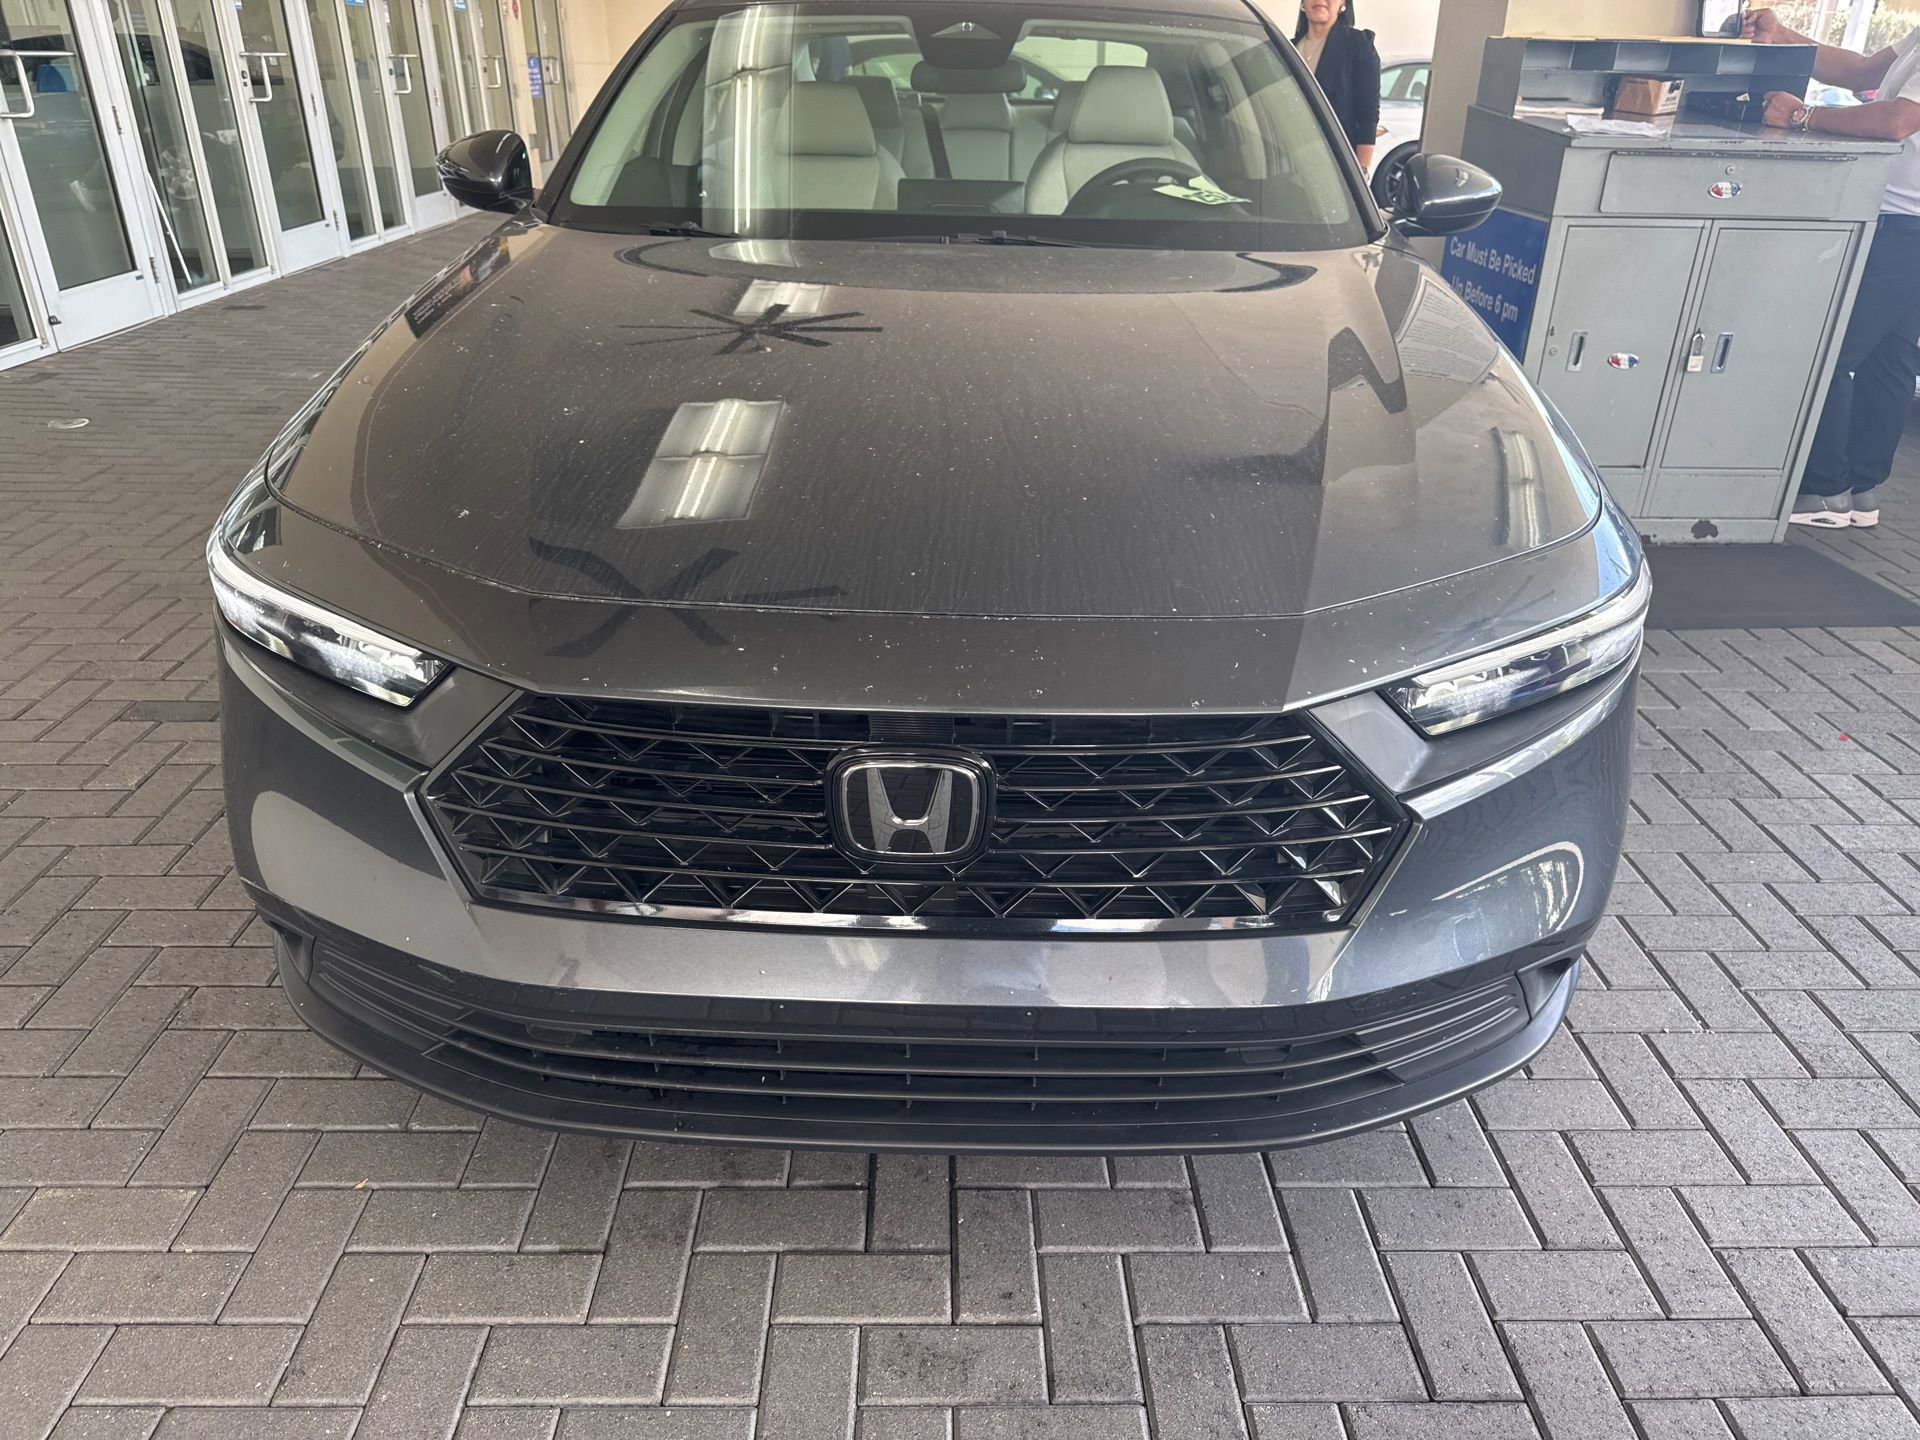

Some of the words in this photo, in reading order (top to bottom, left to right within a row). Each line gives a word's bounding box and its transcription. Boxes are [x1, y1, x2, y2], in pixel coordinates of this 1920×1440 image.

[1450, 236, 1465, 257] Car
[1466, 241, 1488, 267] Must
[1489, 249, 1501, 272] Be
[1502, 254, 1536, 285] Picked
[1464, 280, 1493, 310] Before
[1494, 294, 1502, 315] 6
[1501, 301, 1518, 322] pm
